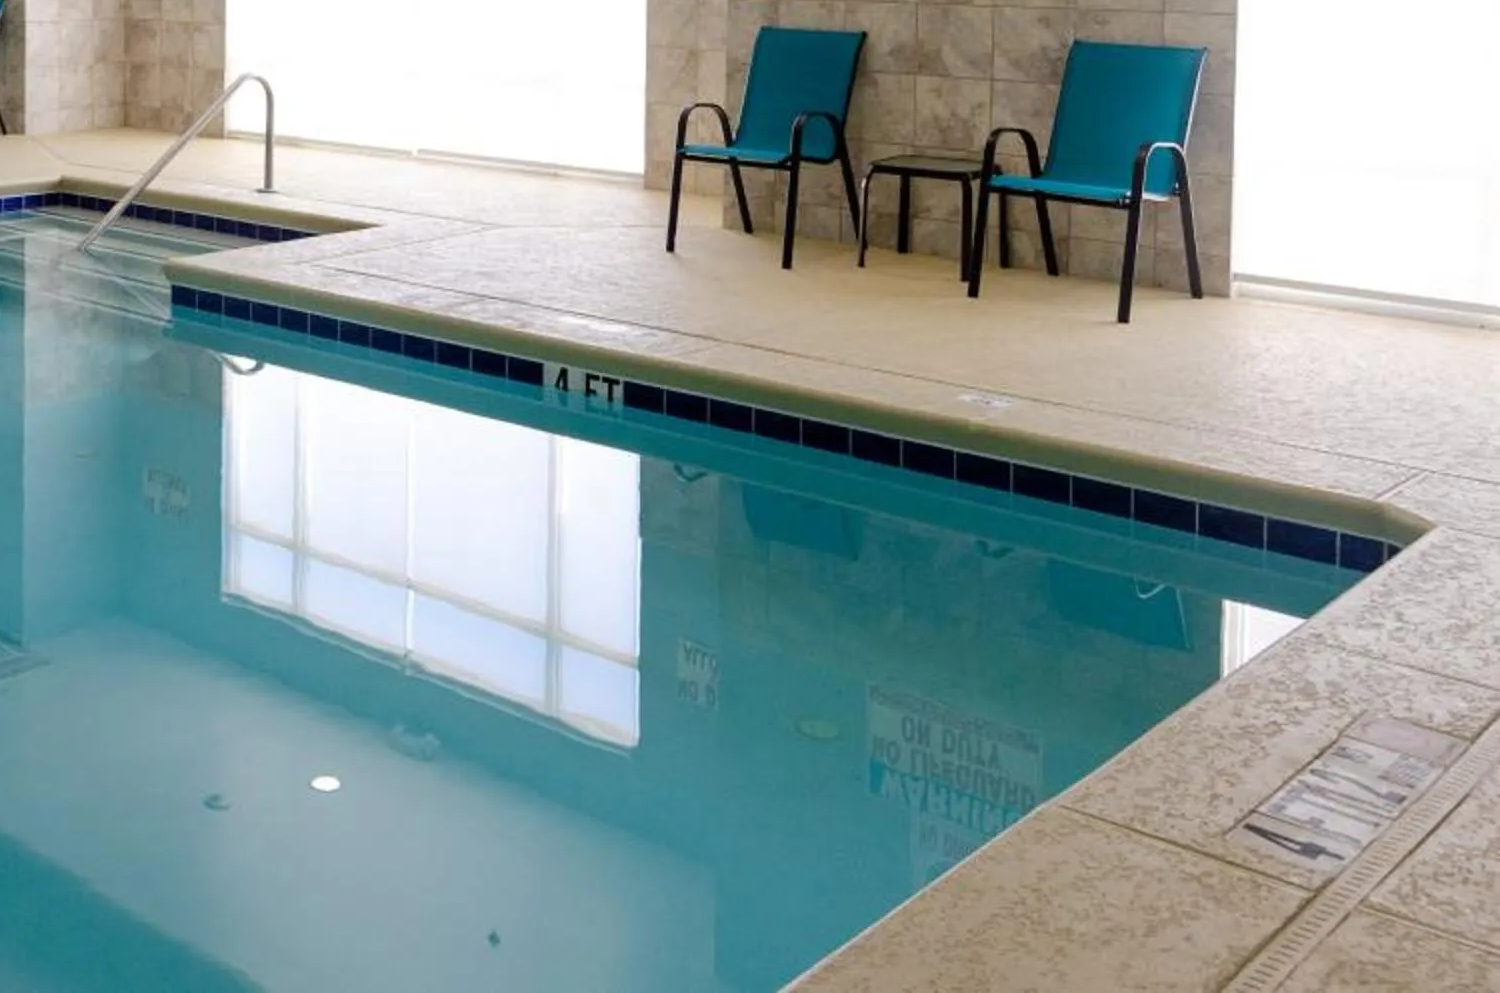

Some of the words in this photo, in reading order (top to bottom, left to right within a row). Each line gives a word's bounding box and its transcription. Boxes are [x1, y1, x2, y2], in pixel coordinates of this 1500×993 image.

[555, 366, 569, 393] 4
[585, 373, 621, 403] FT
[1242, 822, 1345, 861] 4
